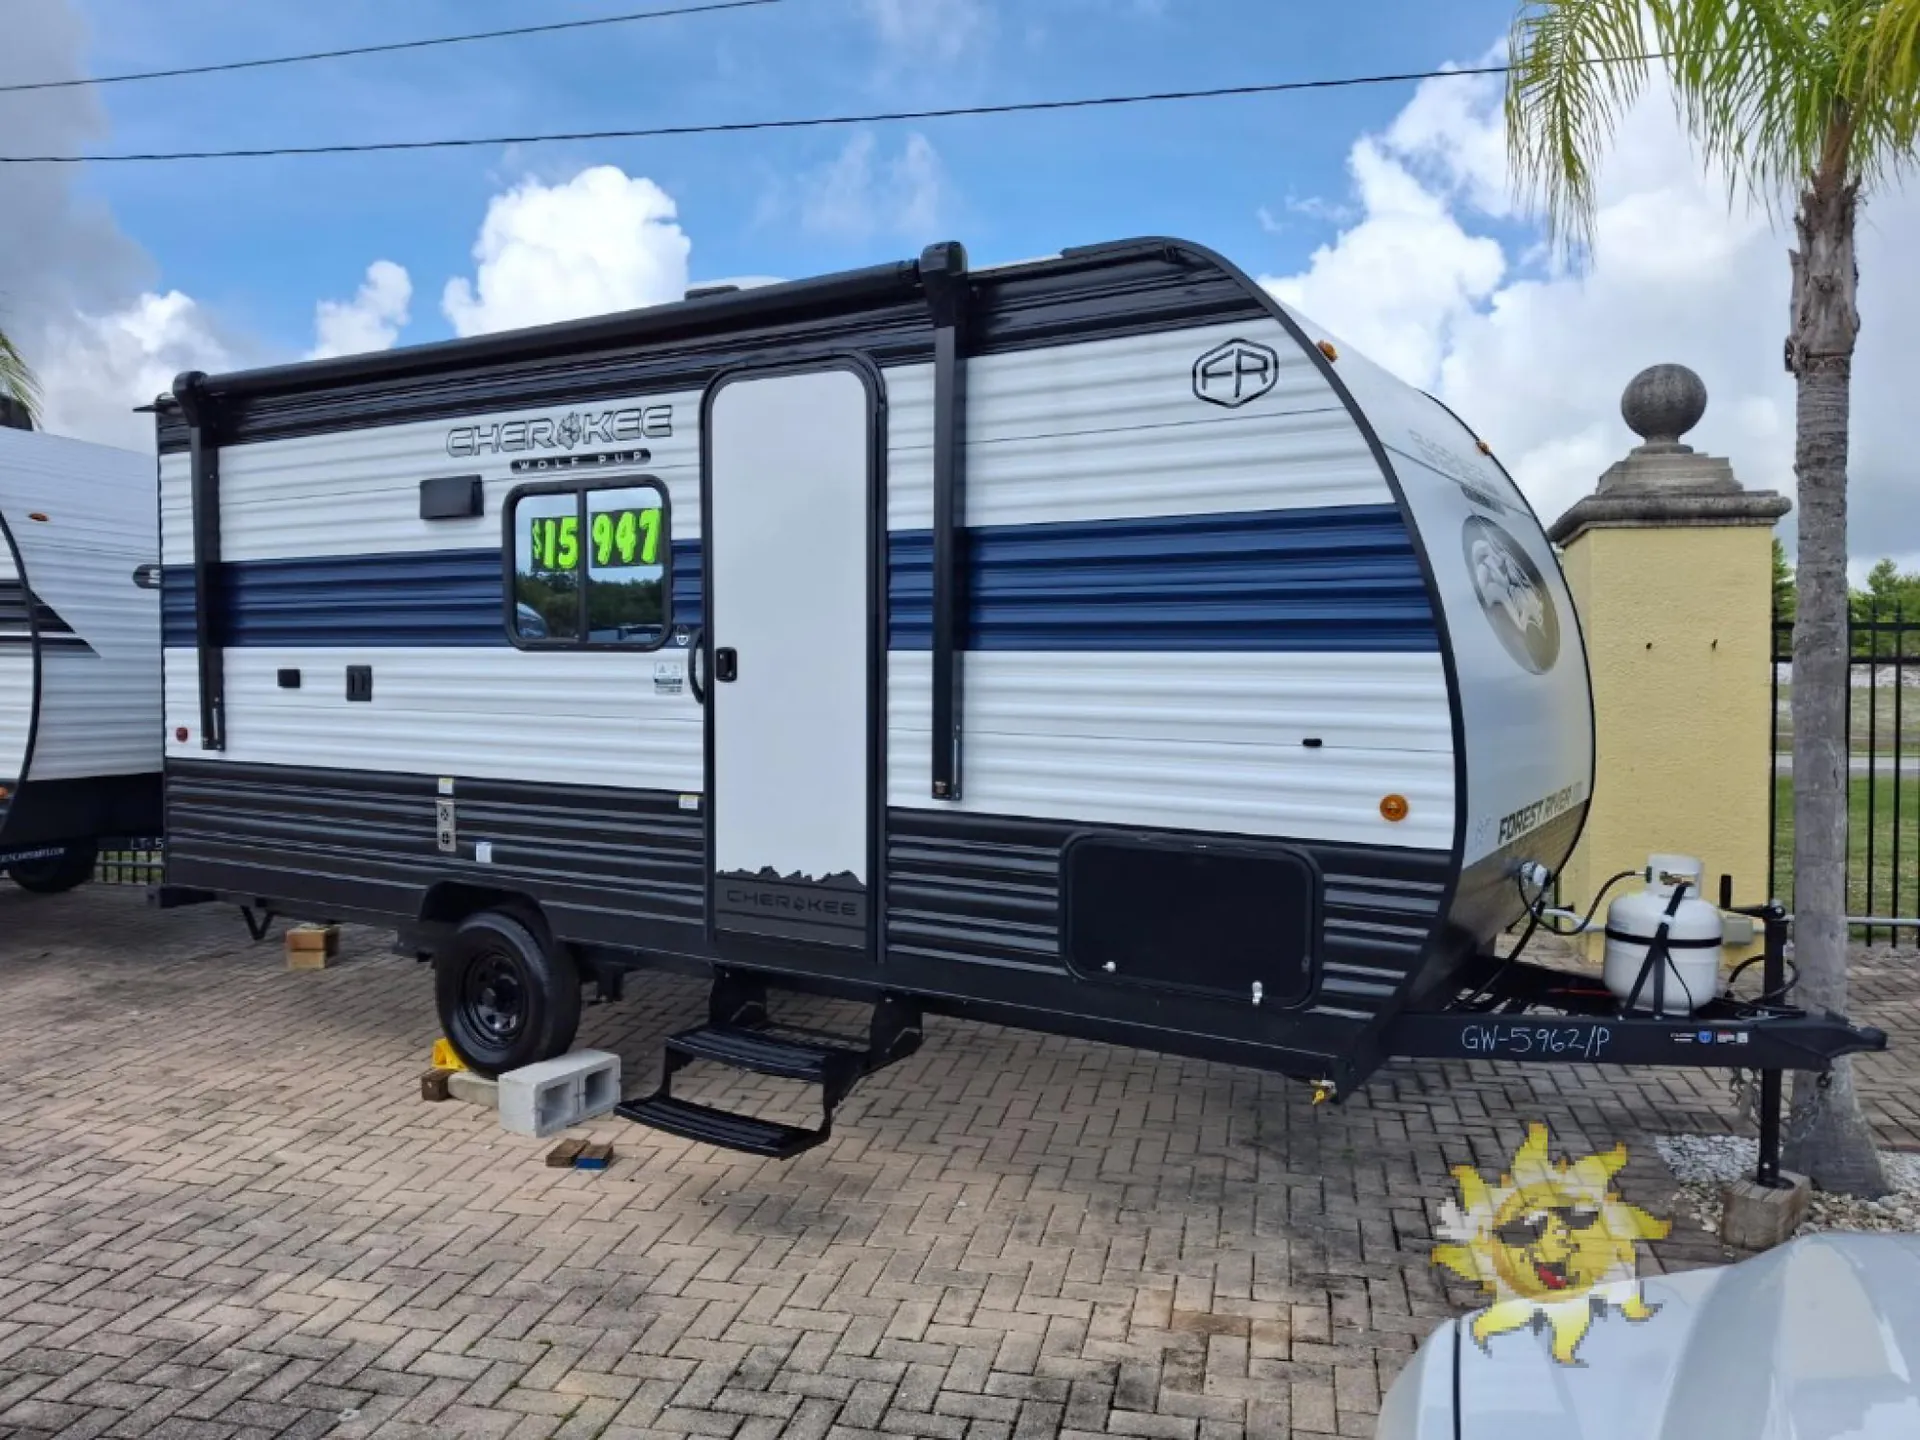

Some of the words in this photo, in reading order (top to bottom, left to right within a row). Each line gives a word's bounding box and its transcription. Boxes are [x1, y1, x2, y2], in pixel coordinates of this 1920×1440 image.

[518, 456, 579, 471] WOLF
[597, 450, 642, 465] PUP
[591, 508, 660, 566] 947
[1498, 797, 1545, 845] FOREST
[726, 889, 858, 916] CHEROKEE
[1461, 1024, 1611, 1058] GW-5962/P
